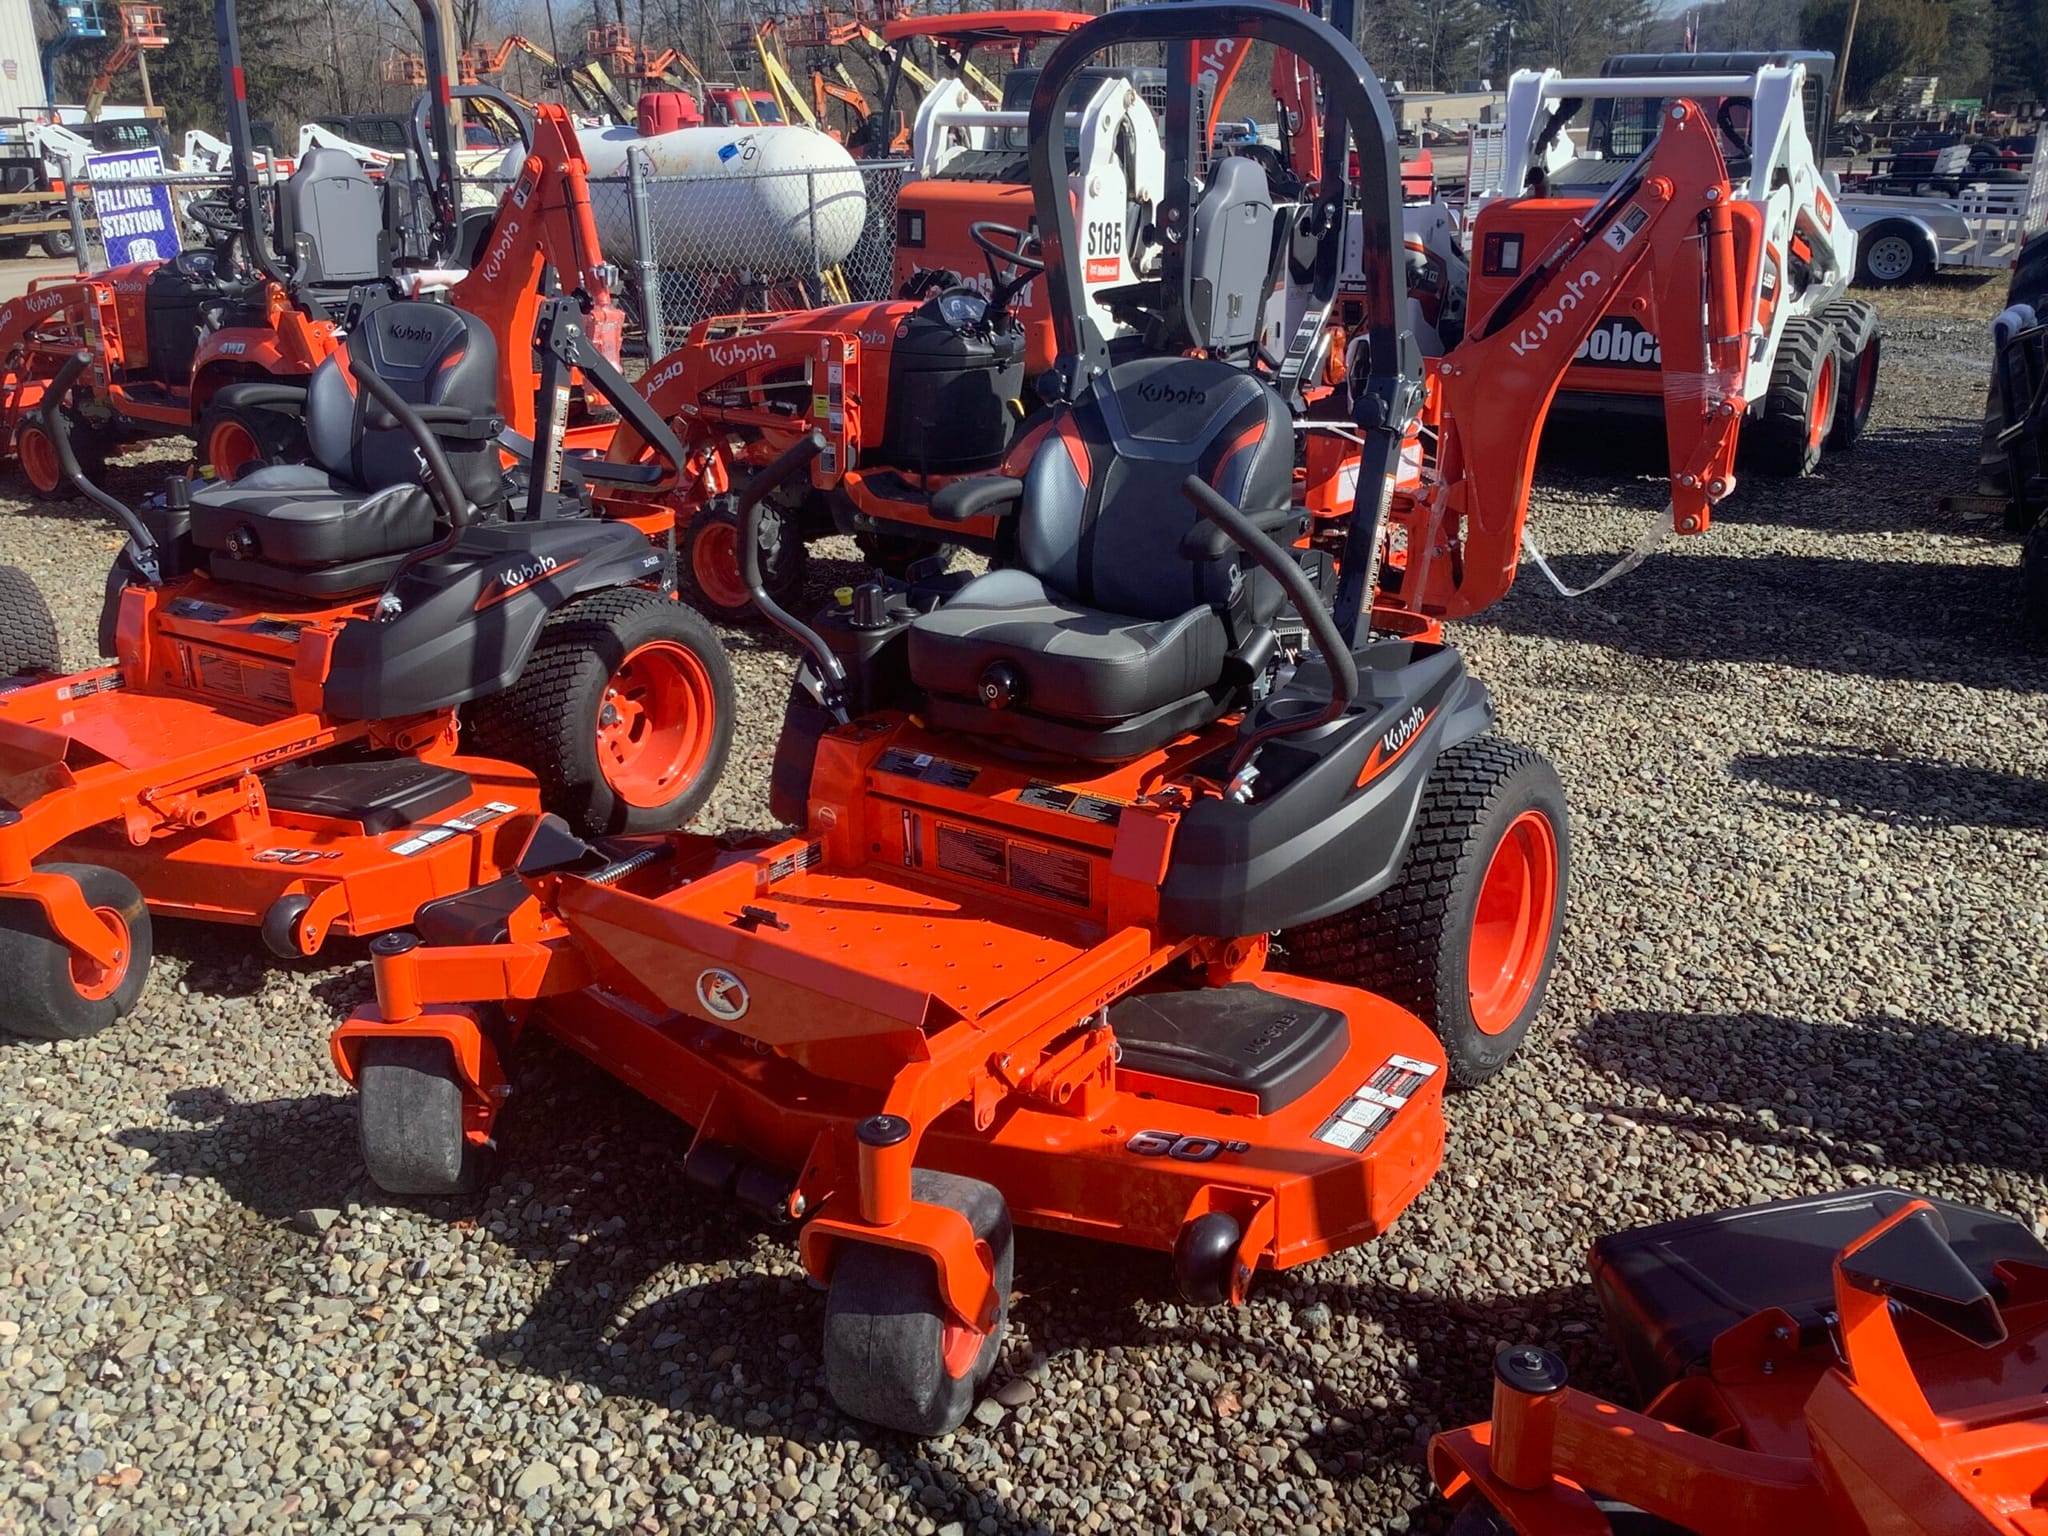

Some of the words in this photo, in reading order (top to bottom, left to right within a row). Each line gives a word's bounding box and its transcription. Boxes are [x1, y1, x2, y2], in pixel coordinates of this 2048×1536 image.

[90, 156, 163, 180] PROPANE
[97, 187, 154, 213] FILLING
[101, 208, 165, 238] STATION
[482, 221, 520, 282] Kubota
[1087, 221, 1122, 255] S185
[26, 293, 64, 313] Kubota
[1509, 270, 1601, 357] Kubota
[390, 324, 432, 341] Kubota
[219, 342, 246, 354] 4WD
[710, 340, 777, 367] Kubota
[1137, 383, 1207, 405] Kubota
[500, 556, 557, 586] Kubota
[1384, 706, 1425, 751] Kubota
[1125, 1129, 1252, 1162] 60"
